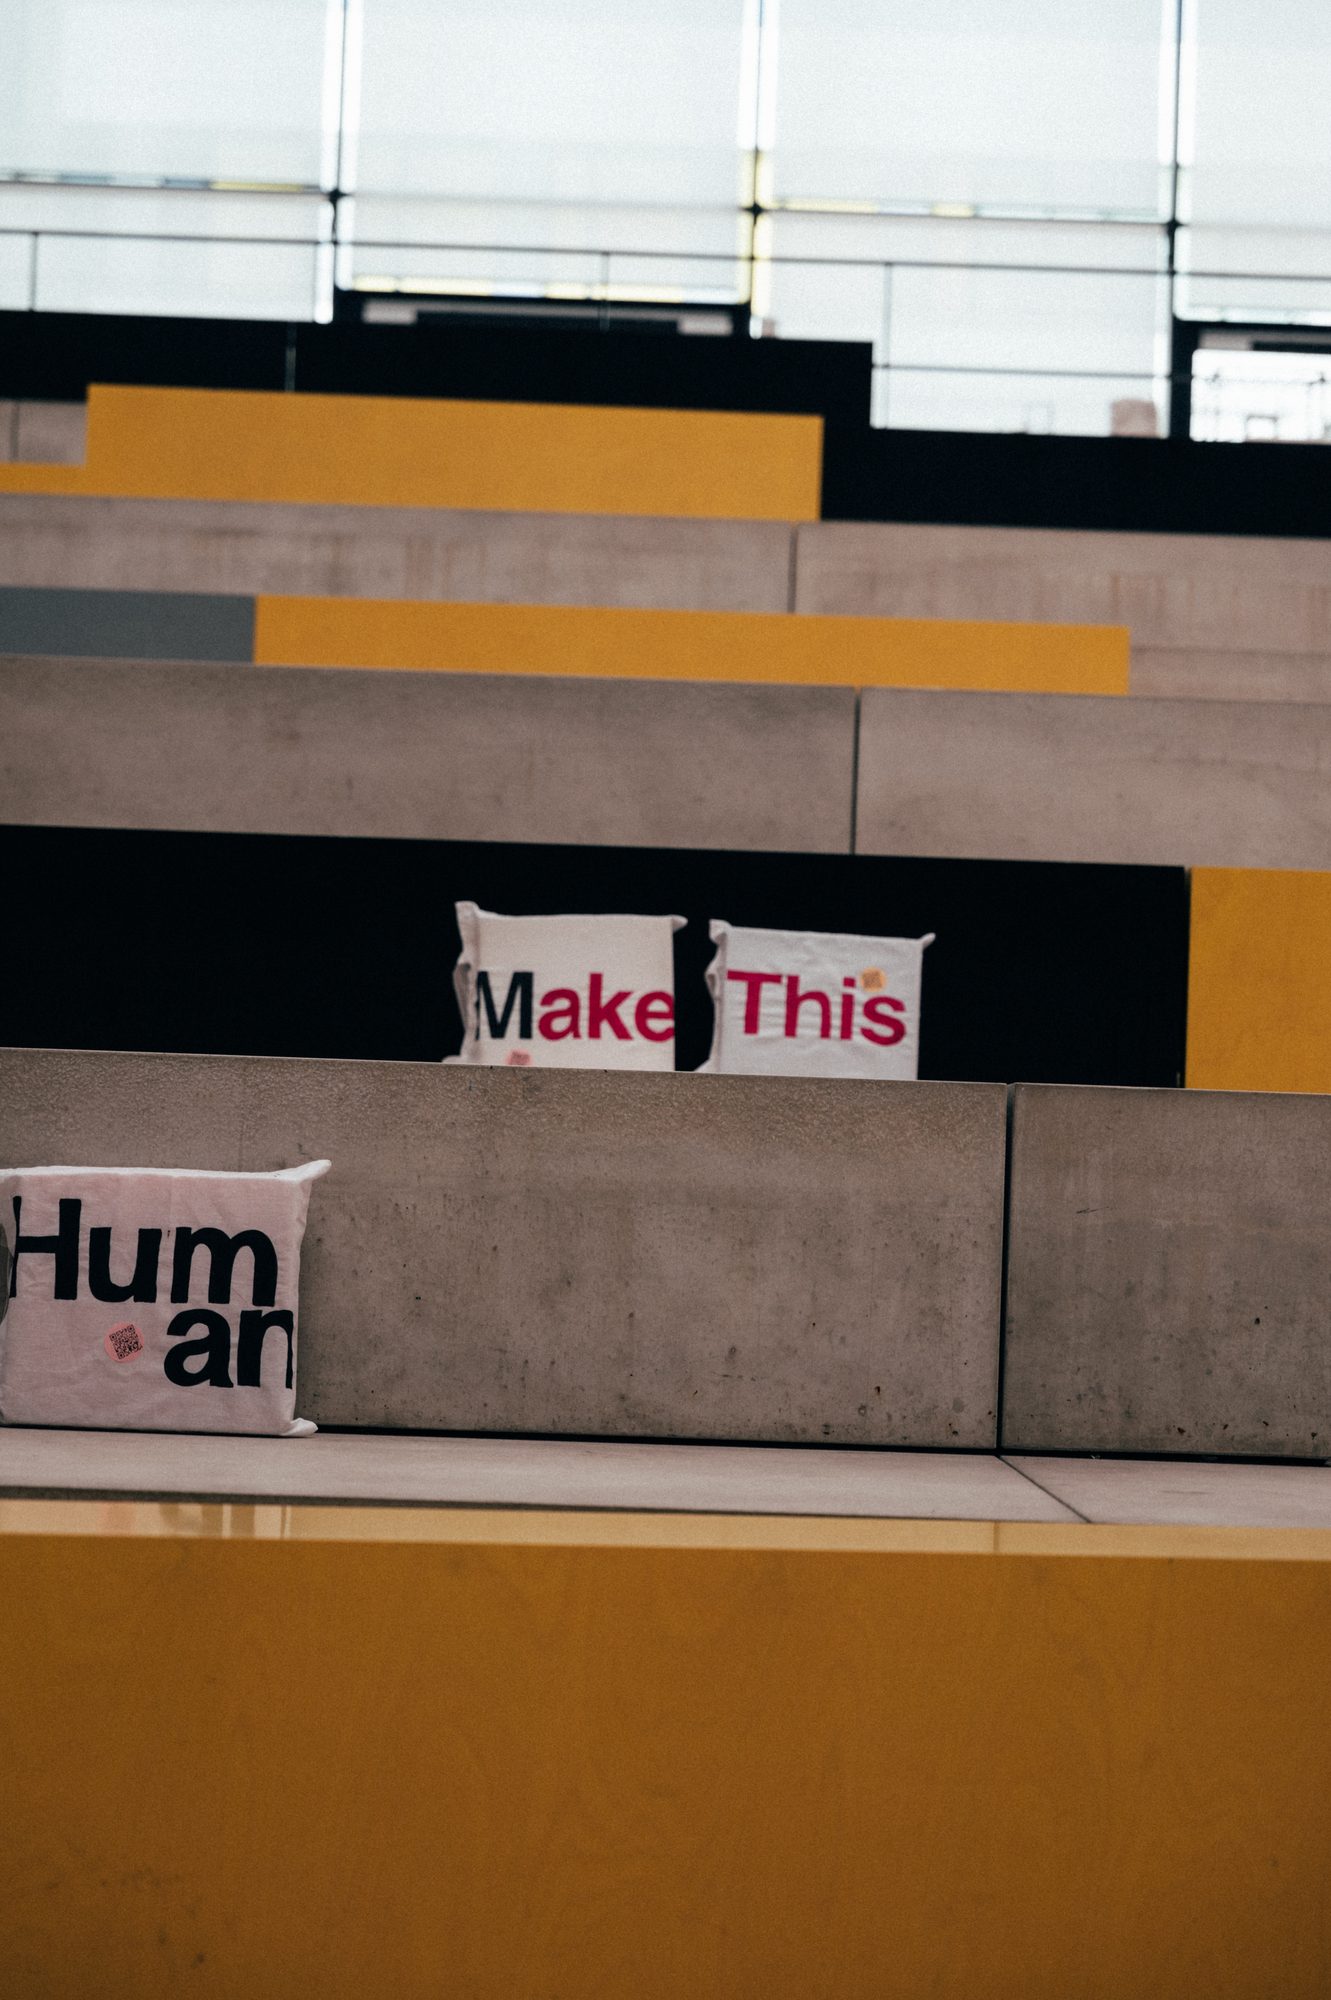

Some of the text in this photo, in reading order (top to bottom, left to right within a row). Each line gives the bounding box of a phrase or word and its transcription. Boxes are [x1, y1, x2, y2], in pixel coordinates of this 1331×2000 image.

[475, 971, 675, 1041] Make
[727, 969, 907, 1046] This
[9, 1195, 278, 1307] Hum
[164, 1308, 294, 1389] an
